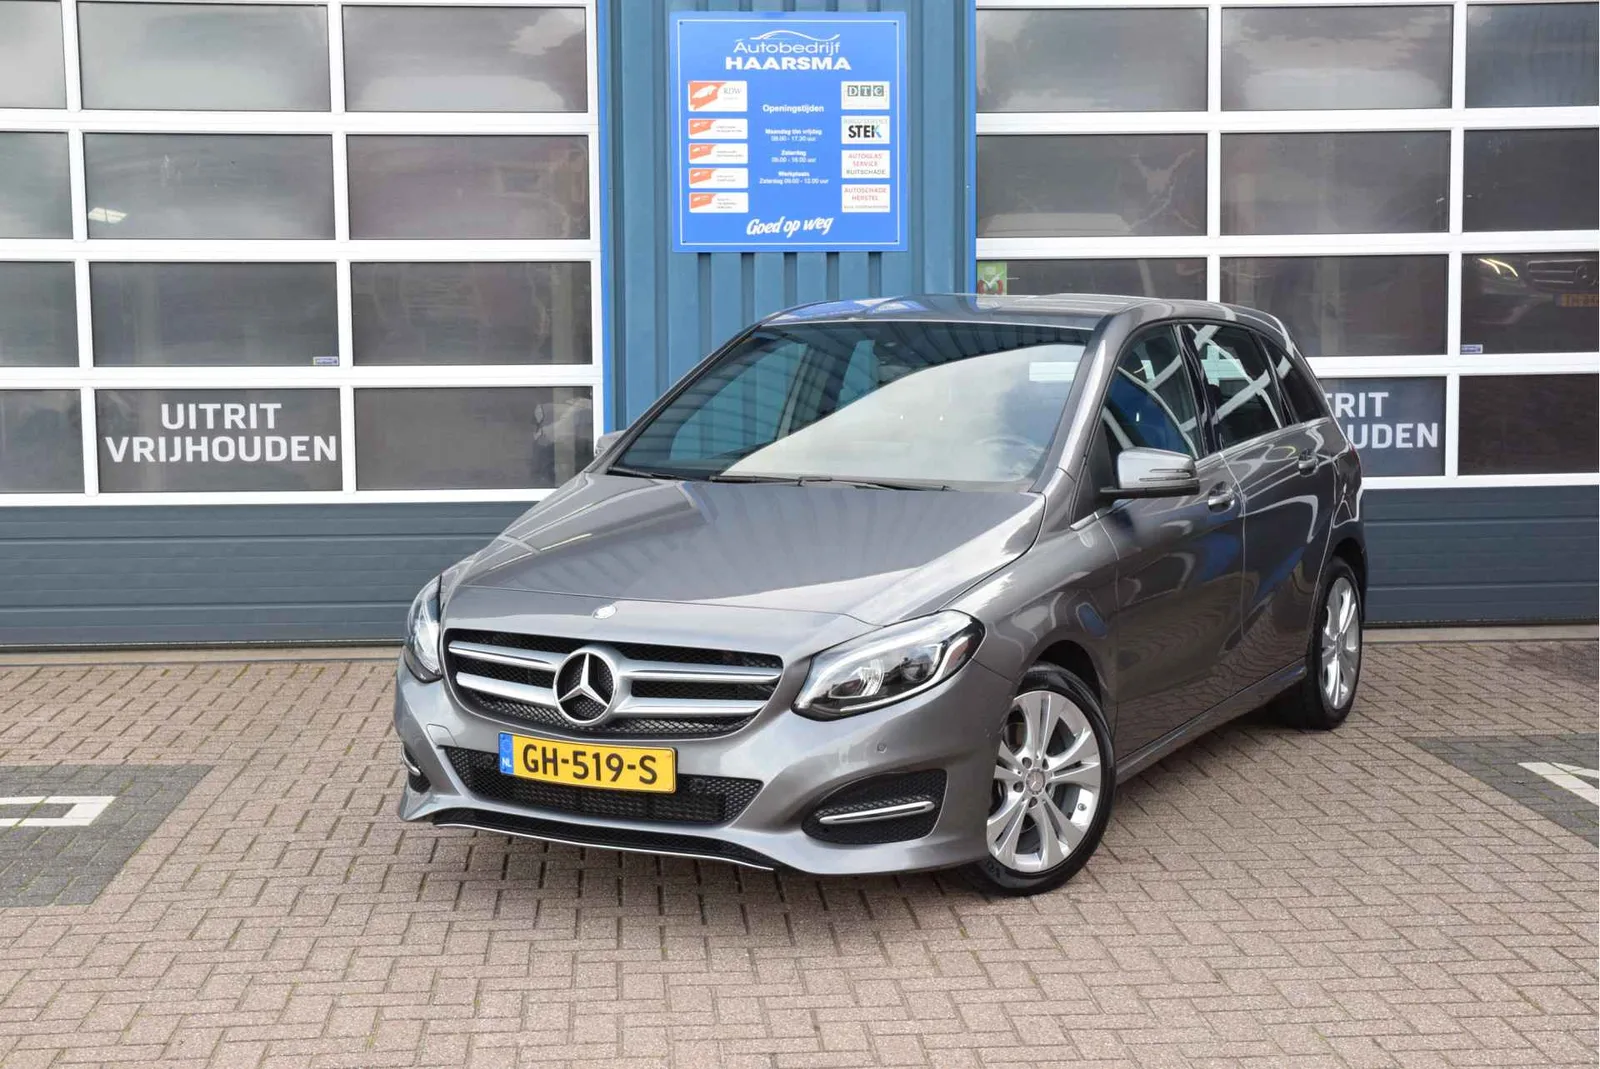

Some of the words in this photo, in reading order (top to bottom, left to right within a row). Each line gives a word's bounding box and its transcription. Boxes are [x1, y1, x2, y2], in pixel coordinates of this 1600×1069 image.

[733, 40, 841, 56] Autobedrijf
[725, 56, 852, 71] HAARSMA
[847, 85, 884, 97] DTC
[762, 103, 825, 114] Openingstijden
[848, 125, 882, 139] STEK
[746, 216, 786, 236] Goed
[783, 219, 801, 239] op
[803, 217, 834, 236] weg
[161, 403, 283, 430] UITRIT
[105, 435, 337, 463] VRIJHOUDEN
[501, 757, 512, 767] NL
[522, 743, 658, 785] GH-519-S
